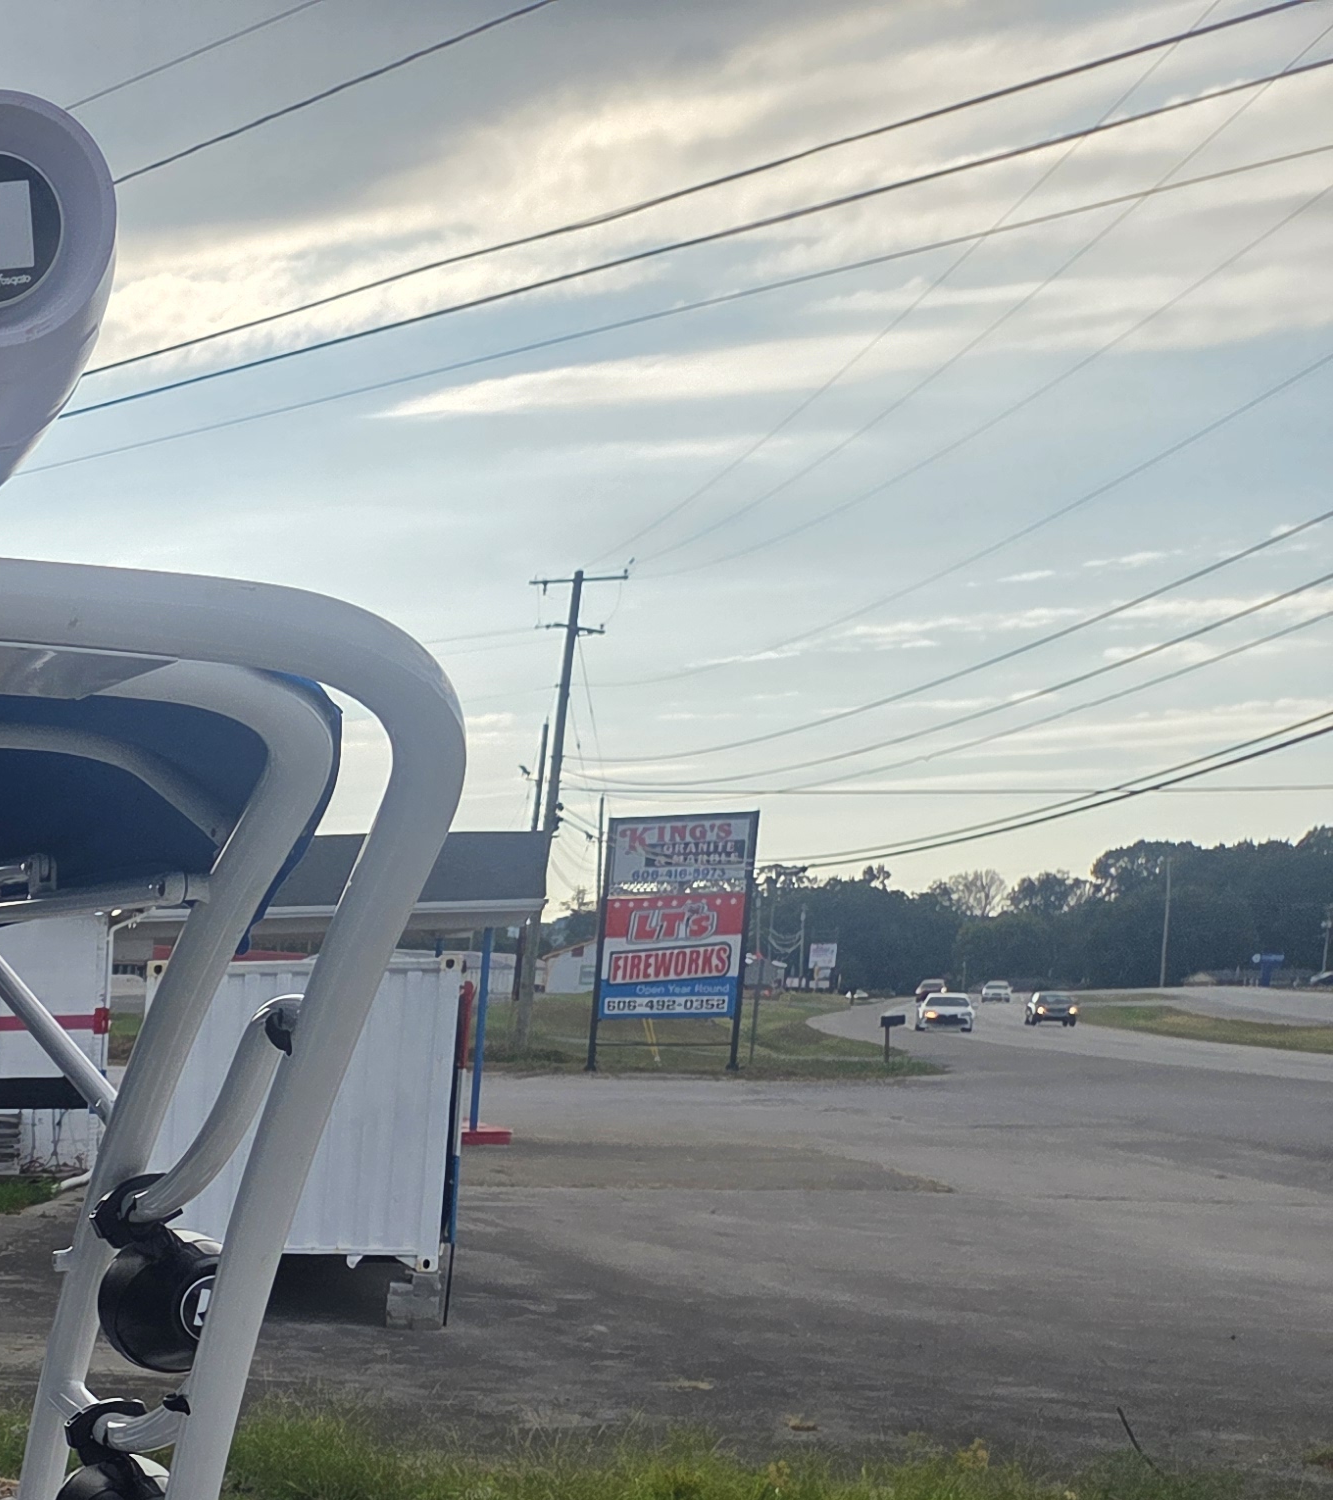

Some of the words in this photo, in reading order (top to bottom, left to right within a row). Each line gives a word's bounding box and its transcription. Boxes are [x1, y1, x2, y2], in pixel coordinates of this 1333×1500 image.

[618, 822, 733, 855] KING'S
[663, 841, 736, 854] GRANITE
[611, 946, 728, 982] FIREWORKS
[635, 984, 665, 995] Open
[667, 984, 692, 994] Year
[694, 983, 730, 994] Round
[606, 998, 727, 1012] 606-492-0352
